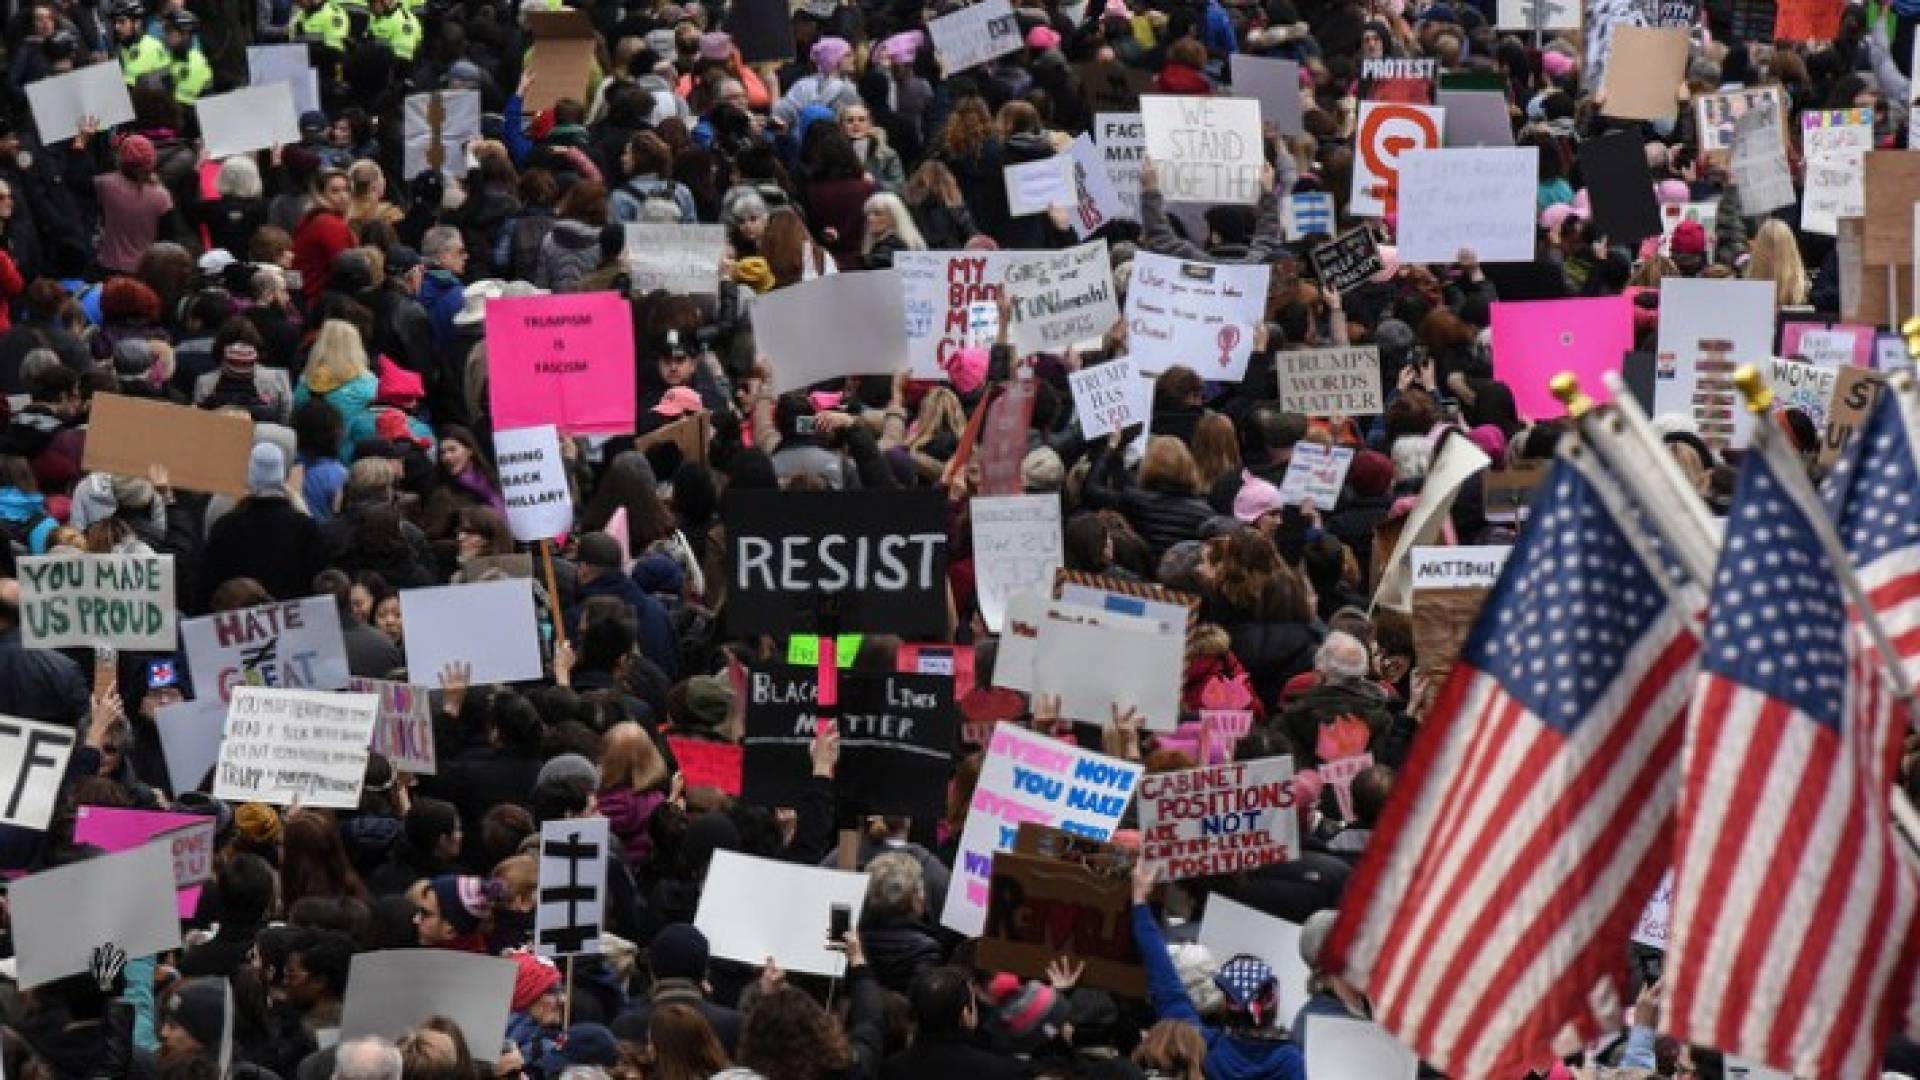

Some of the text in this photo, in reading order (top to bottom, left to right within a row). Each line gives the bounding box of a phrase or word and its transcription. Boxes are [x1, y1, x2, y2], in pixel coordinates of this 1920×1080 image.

[1363, 59, 1435, 79] PROTEST
[1176, 96, 1217, 127] WE
[1104, 123, 1146, 138] FACT
[1168, 129, 1246, 161] STAND
[947, 256, 988, 284] MY
[949, 283, 1004, 308] BOD
[523, 314, 593, 328] TRUMPISM
[945, 308, 968, 333] M
[553, 339, 565, 350] IS
[534, 360, 589, 374] FASCISM
[1076, 364, 1130, 393] TRUMP
[1773, 361, 1836, 394] WOME
[1290, 374, 1368, 392] WORDS
[1090, 390, 1125, 409] HAS
[1284, 392, 1377, 411] MATTER
[499, 448, 544, 465] BRING
[500, 472, 542, 486] BACK
[505, 487, 565, 508] HILLARY
[23, 558, 160, 594] YOU MADE
[736, 533, 949, 593] RESIST
[26, 596, 163, 639] US PROUD
[213, 604, 305, 648] HATE
[794, 714, 914, 738] MTTER
[222, 761, 264, 790] TRUMP
[1074, 758, 1135, 791] MOVE
[1142, 765, 1247, 800] CABINET
[1012, 767, 1124, 818] YOU MAKE
[1157, 779, 1294, 822] POSITIONS
[1144, 809, 1261, 844] ARE NOT
[1144, 829, 1272, 860] ENTRY-LEVEL
[1168, 844, 1289, 878] POSITIONS
